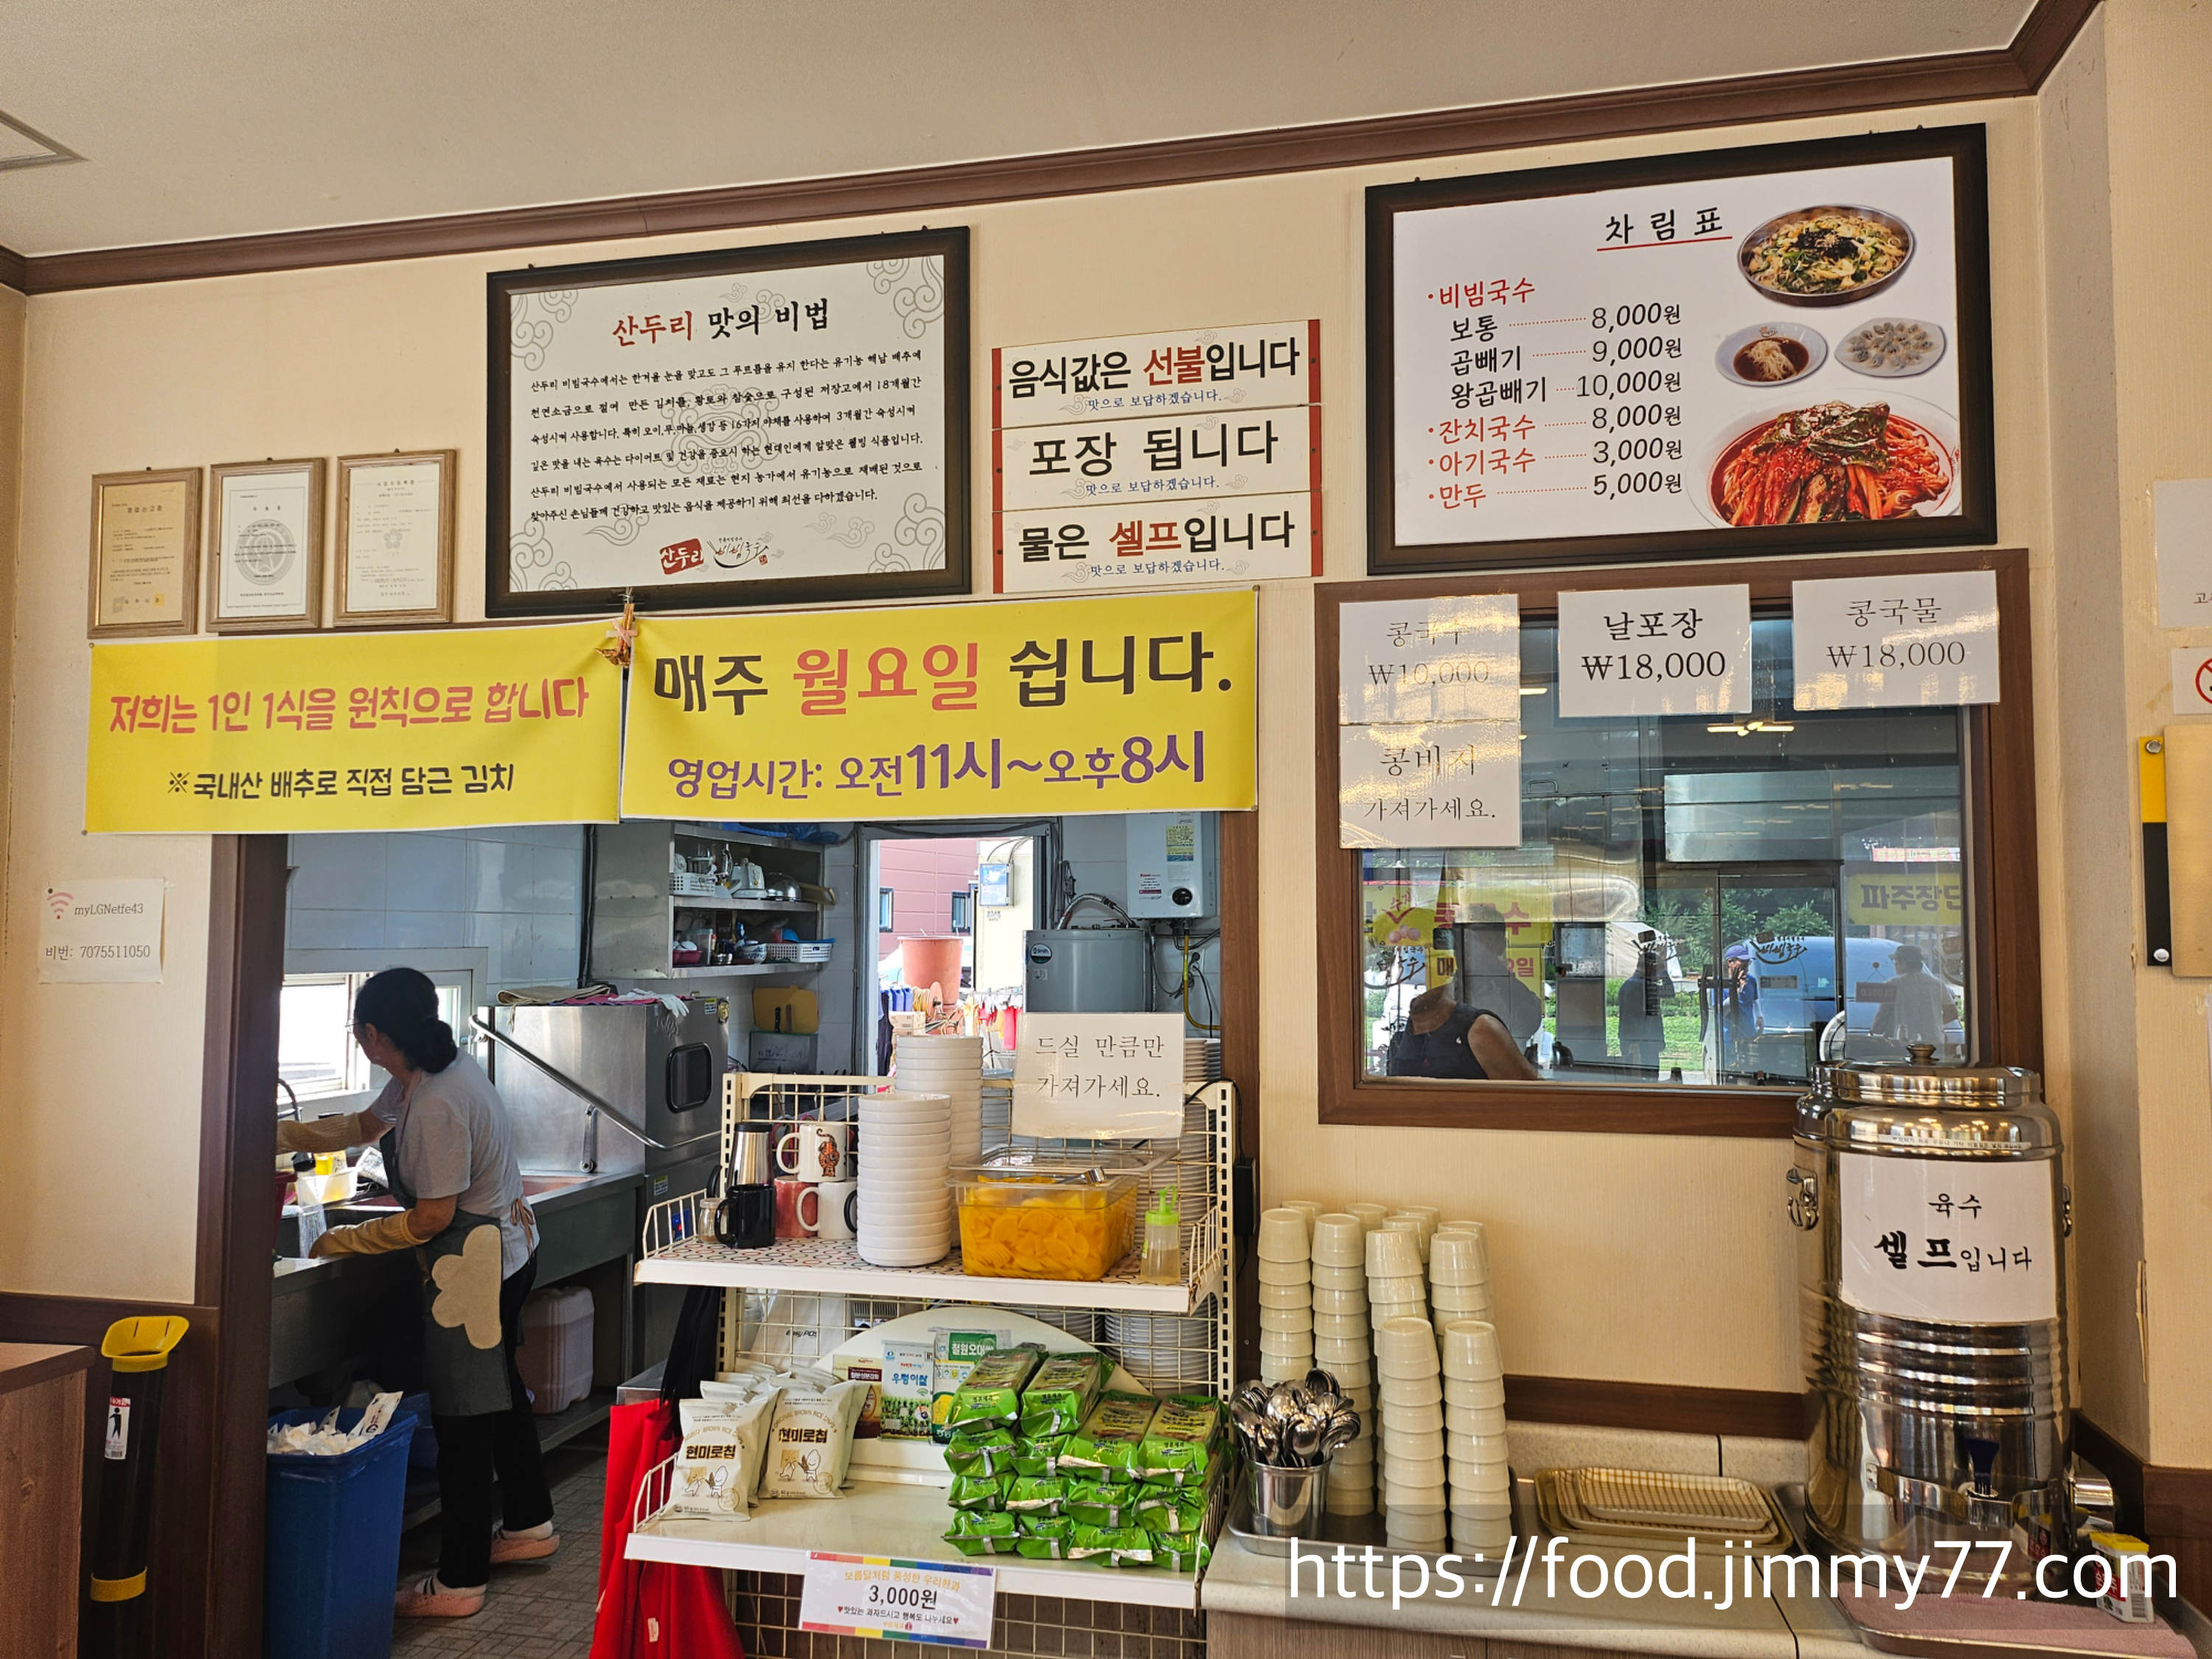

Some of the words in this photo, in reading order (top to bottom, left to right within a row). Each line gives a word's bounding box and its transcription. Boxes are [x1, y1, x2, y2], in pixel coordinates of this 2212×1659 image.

[613, 310, 692, 347] 산두리
[709, 307, 759, 339] 맛의
[775, 298, 827, 332] 비법
[1450, 315, 1498, 342] 보통
[1591, 302, 1681, 334] 8,000원
[531, 379, 557, 392] 산두리
[563, 374, 627, 389] 비빔국수에서는
[633, 372, 660, 384] 한겨울
[664, 370, 683, 382] 눈을
[688, 368, 716, 379] 맞고도
[720, 368, 728, 377] 그
[776, 361, 795, 373] 유지
[800, 358, 830, 370] 한다는
[833, 355, 863, 368] 유기농
[868, 352, 887, 364] 해남
[892, 349, 921, 362] 배추에
[1009, 351, 1131, 398] 음식값은
[1143, 337, 1300, 386] 선불입니다
[1450, 346, 1521, 376] 곱빼기
[1592, 336, 1682, 366] 9,000원
[531, 405, 594, 418] 천연소금으로
[629, 399, 650, 411] 만든
[695, 393, 727, 406] 황토와
[781, 386, 814, 399] 구성된
[821, 380, 872, 395] 저장고에서
[1088, 397, 1125, 411] 맛으로
[1130, 389, 1222, 407] 보답하겠습니다.
[1450, 377, 1547, 409] 왕곱빼기
[1576, 370, 1682, 400] 10,000원
[531, 431, 567, 445] 숙성시켜
[570, 428, 619, 441] 사용합니다.
[623, 426, 640, 438] 특히
[718, 420, 727, 431] 등
[731, 417, 759, 429] 16가지
[763, 416, 790, 428] 야채를
[794, 412, 830, 425] 사용하여
[837, 408, 872, 421] 3개월간
[876, 405, 916, 418] 숙성시켜
[1592, 404, 1681, 434] 8,000원
[531, 459, 549, 472] 깊은
[552, 458, 569, 470] 맛을
[574, 456, 591, 468] 내는
[594, 454, 622, 466] 육수는
[625, 453, 662, 464] 다이어트
[666, 451, 675, 462] 및
[678, 448, 706, 462] 건강을
[710, 445, 737, 458] 중요시
[742, 445, 760, 457] 하는
[765, 441, 811, 455] 현대인에게
[815, 439, 844, 452] 알맞은
[848, 436, 866, 448] 웰빙
[871, 433, 923, 447] 식품입니다.
[1029, 432, 1117, 477] 포장
[1143, 420, 1279, 471] 됩니다
[1592, 437, 1683, 467] 3,000원
[531, 485, 559, 498] 산두리
[563, 481, 622, 495] 비빔국수에서
[627, 479, 667, 491] 사용되는
[671, 477, 692, 488] 모든
[695, 475, 726, 487] 재료는
[731, 472, 750, 485] 현지
[754, 470, 796, 483] 농가에서
[800, 467, 854, 479] 유기농으로
[858, 463, 888, 476] 재배된
[893, 462, 922, 474] 것으로
[1085, 481, 1122, 496] 맛으로
[1128, 476, 1220, 493] 보답하겠습니다.
[1593, 470, 1682, 501] 5,000원
[531, 508, 567, 522] 찾아주신
[570, 506, 608, 520] 손님들께
[611, 504, 650, 516] 건강하고
[653, 501, 681, 514] 맛있는
[684, 499, 713, 512] 음식을
[717, 497, 755, 509] 제공하기
[758, 495, 778, 507] 위해
[781, 493, 811, 505] 최선을
[814, 489, 877, 503] 다하겠습니다.
[1018, 524, 1089, 563] 물은
[1109, 511, 1295, 557] 셀프입니다
[660, 547, 703, 568] 산두리
[1091, 563, 1127, 577] 맛으로
[1133, 558, 1225, 574] 보답하겠습니다.
[1604, 607, 1704, 641] 날포장
[1846, 596, 1943, 627] 콩국물
[1582, 650, 1726, 682] ₩18,000
[1826, 640, 1966, 669] ₩18,000
[654, 653, 769, 717] 매주
[793, 641, 979, 717] 월요일
[1009, 630, 1232, 709] 쉽니다.
[110, 694, 198, 734] 저희는
[209, 692, 251, 732] 1인
[264, 687, 336, 731] 1식을
[349, 685, 473, 730] 원칙으로
[484, 676, 589, 723] 합니다
[1380, 744, 1475, 776] 콩비지
[271, 768, 338, 799] 배추로
[346, 768, 392, 796] 직접
[401, 766, 453, 796] 담근
[461, 763, 515, 794] 김치
[667, 759, 823, 801] 영업시간:
[1364, 797, 1495, 821] 가져가세요.
[74, 903, 144, 917] myLGNetfe43
[46, 945, 73, 961] 비번:
[80, 945, 151, 959] 7075511050
[1035, 1034, 1079, 1058] 드실
[1096, 1034, 1165, 1059] 만큼만
[1037, 1074, 1161, 1099] 가져가세요.
[1928, 1192, 1983, 1219] 육수
[779, 1427, 828, 1443] 현미로칩
[686, 1444, 736, 1460] 현미로칩
[894, 1571, 920, 1583] 풍성한
[869, 1585, 937, 1610] 3,000원
[866, 1608, 900, 1618] 과자드시고
[902, 1612, 922, 1621] 행복도
